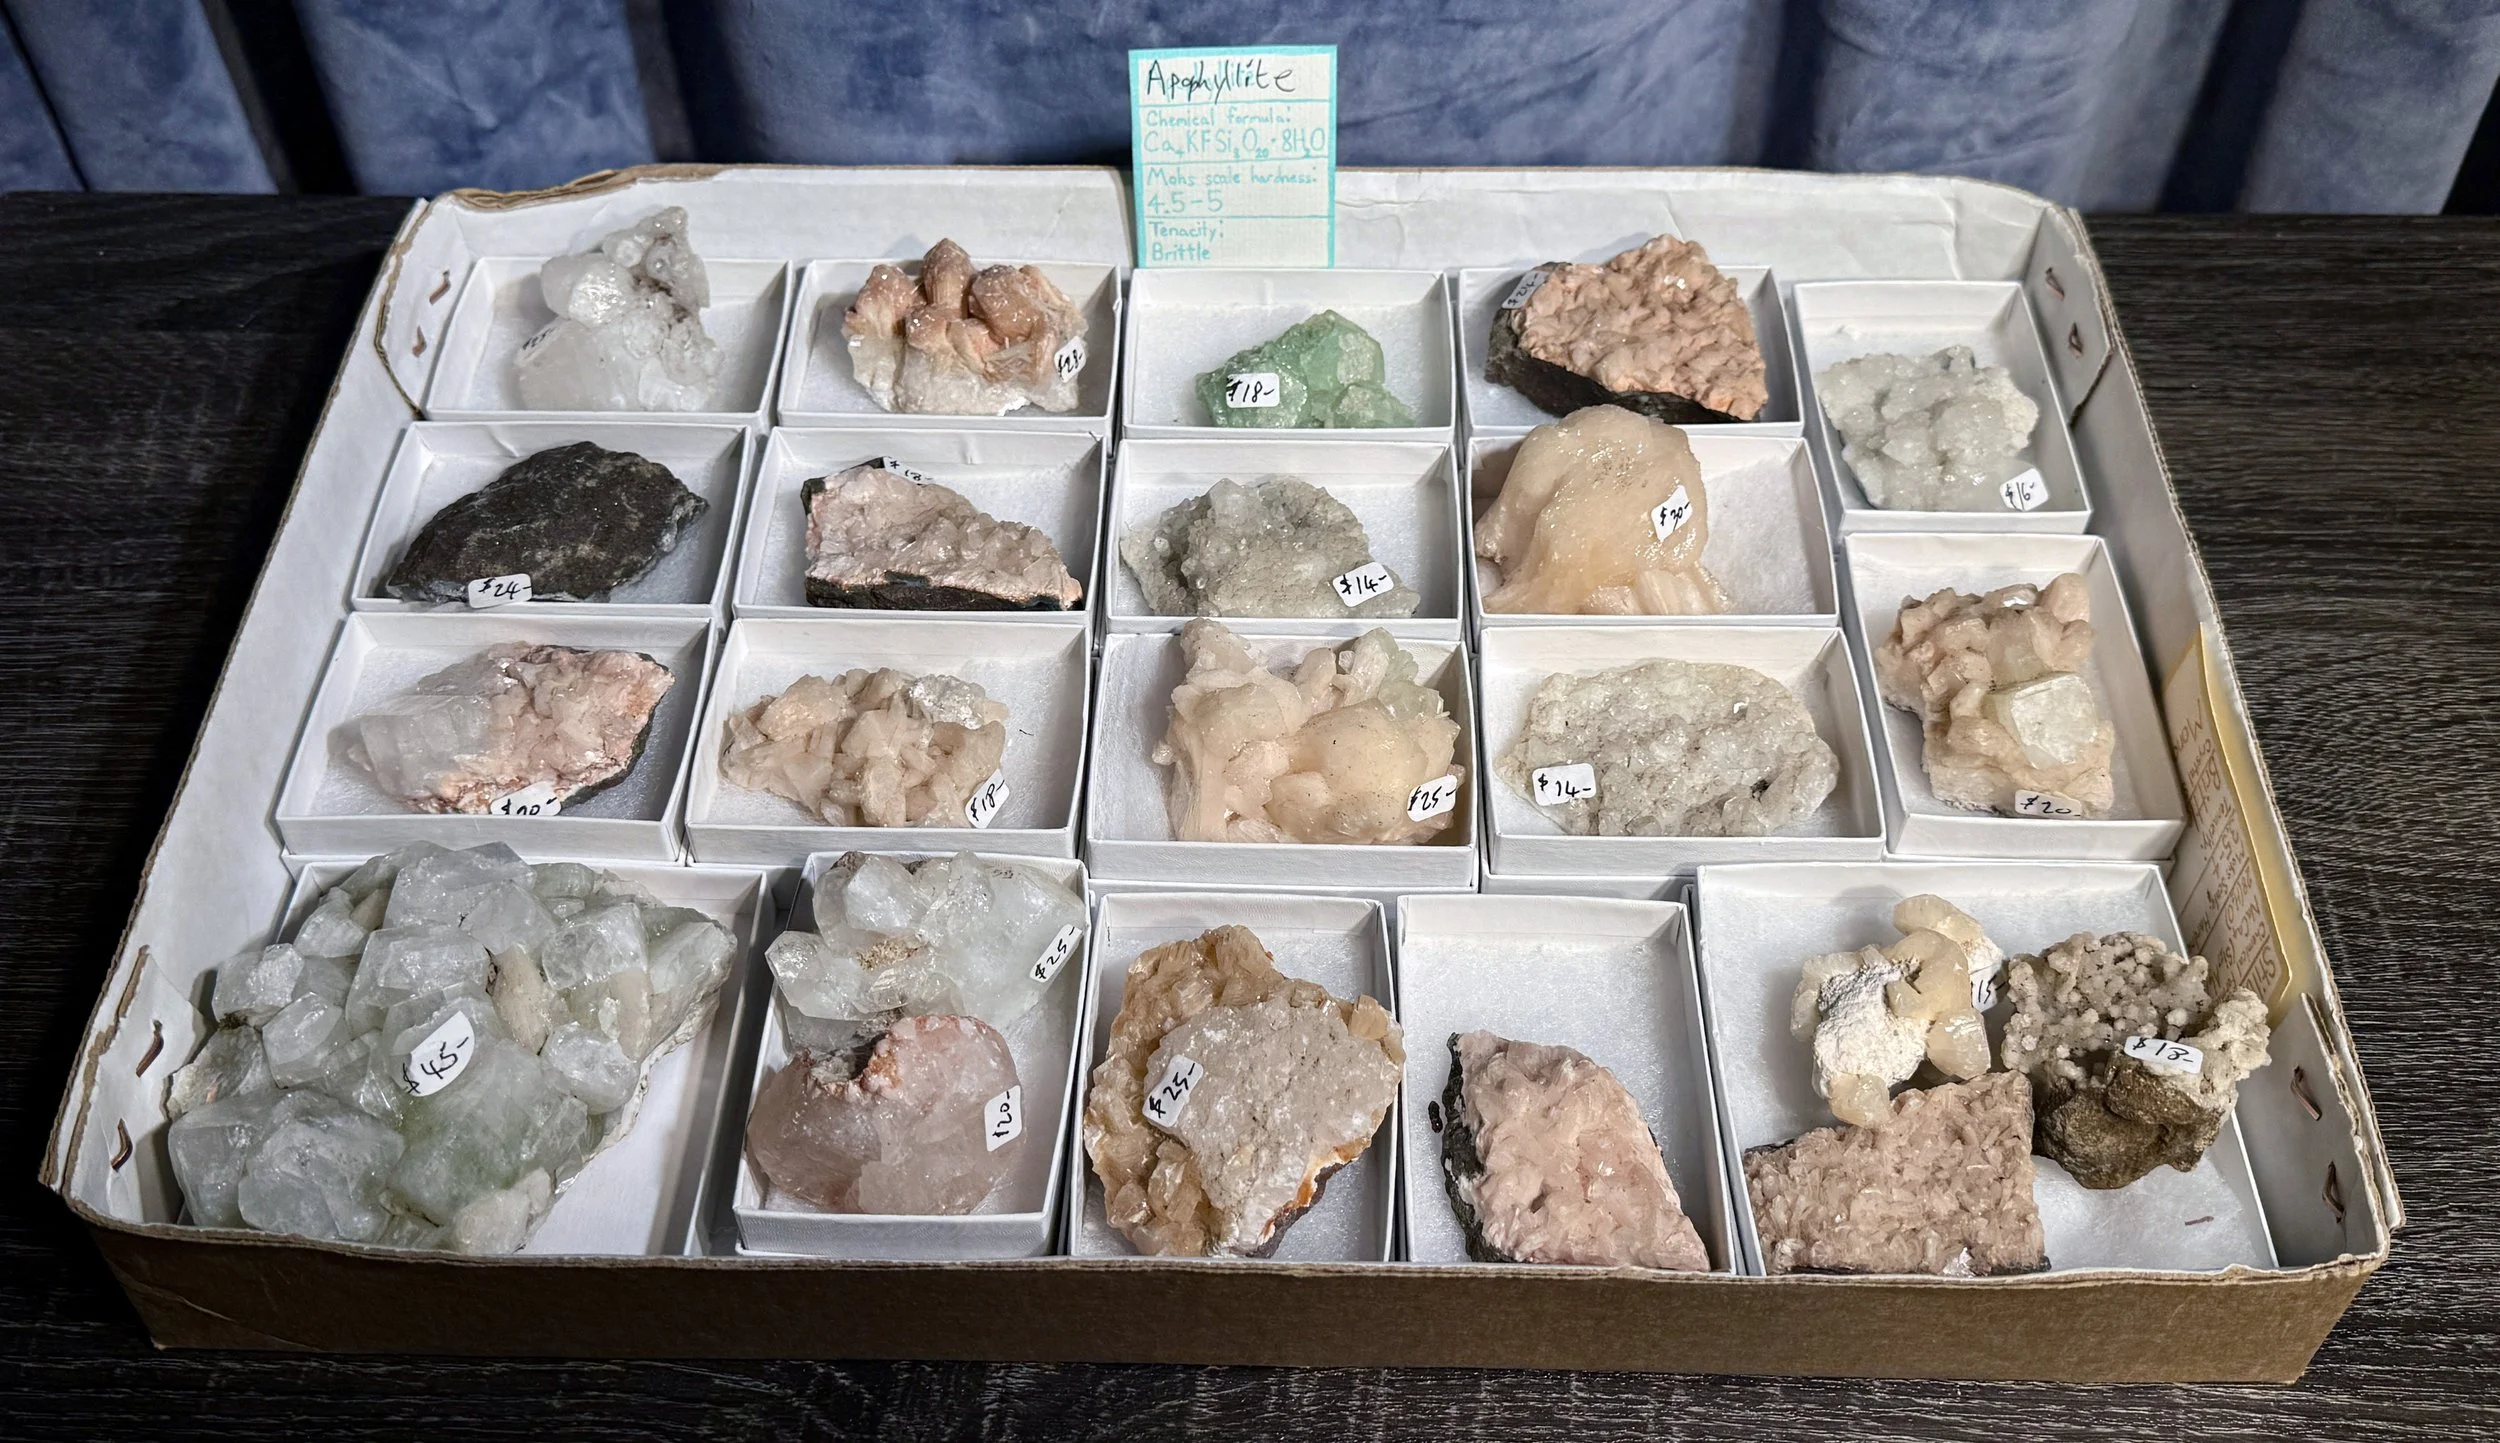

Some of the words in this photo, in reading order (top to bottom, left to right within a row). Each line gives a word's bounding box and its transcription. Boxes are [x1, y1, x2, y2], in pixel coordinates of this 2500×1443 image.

[1147, 59, 1296, 104] Apophyllite
[1146, 107, 1216, 127] Chemical
[1228, 106, 1292, 124] formula:
[1146, 167, 1196, 186] Mohs
[1206, 166, 1241, 184] scale
[1250, 164, 1318, 184] hardness:
[1149, 220, 1225, 243] Tenacity:
[1151, 242, 1211, 262] Brittle
